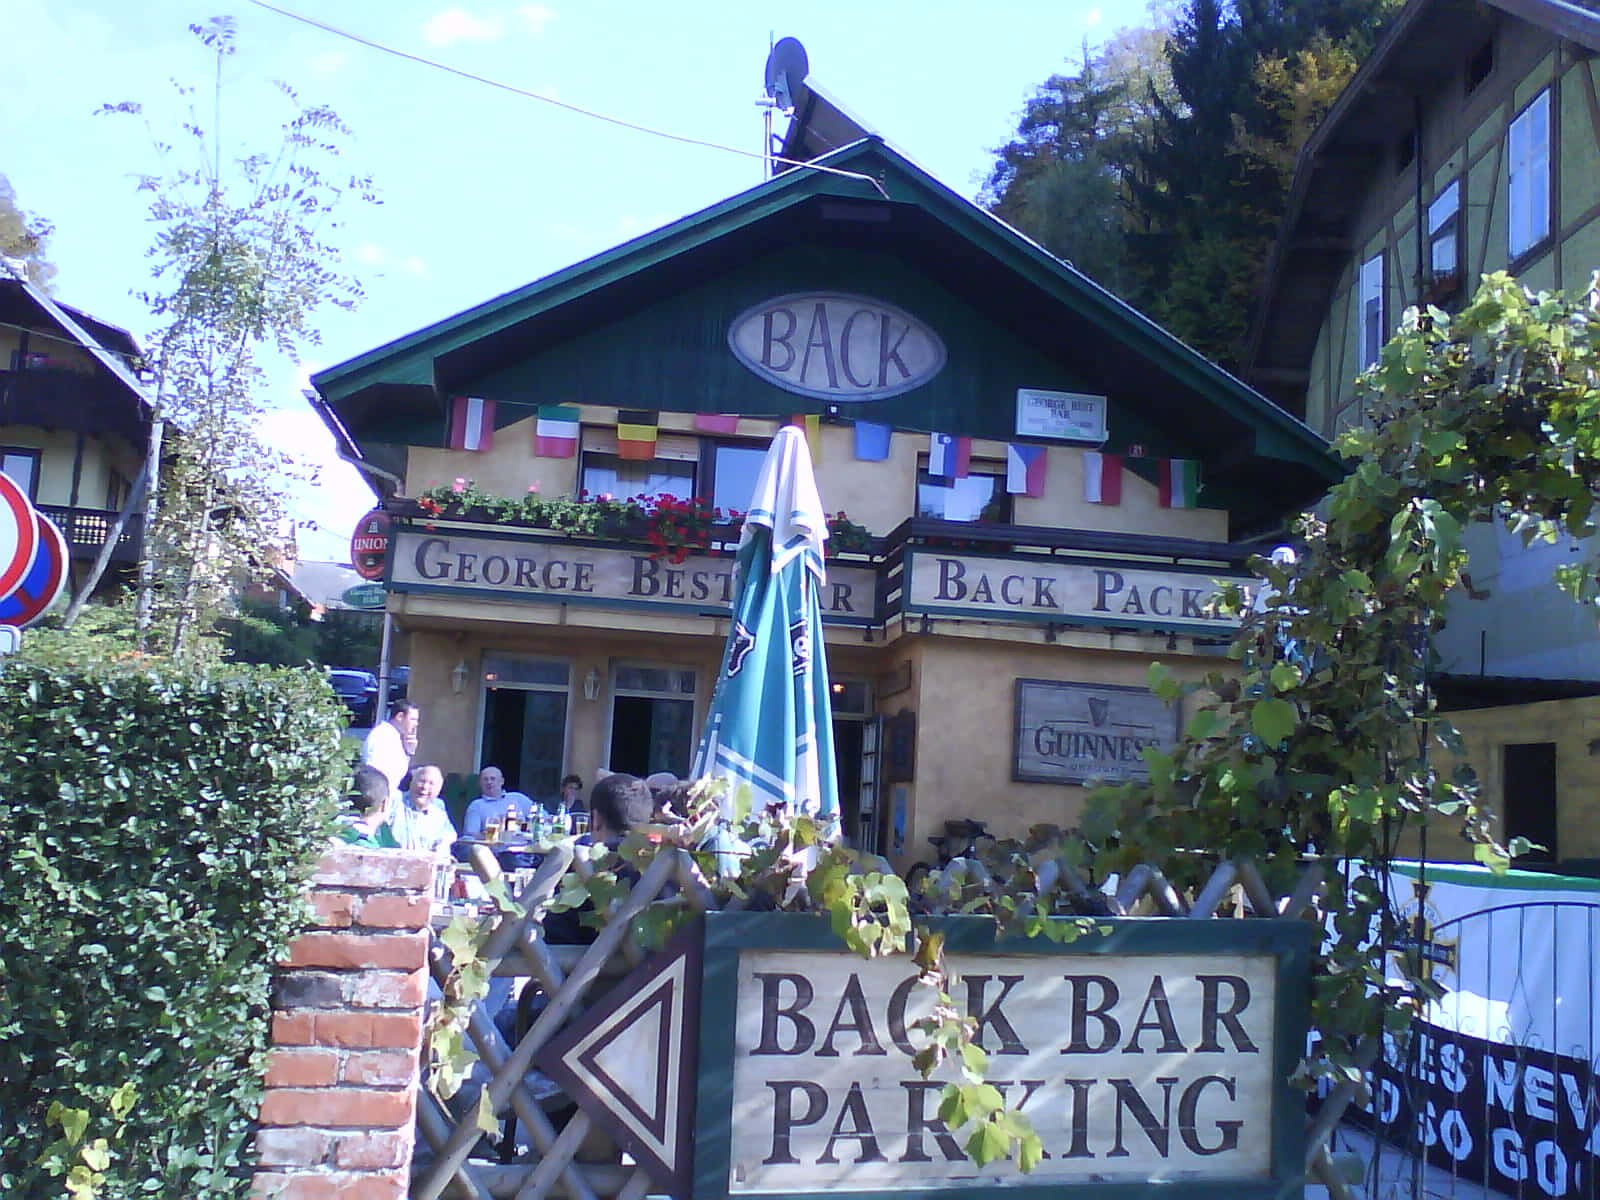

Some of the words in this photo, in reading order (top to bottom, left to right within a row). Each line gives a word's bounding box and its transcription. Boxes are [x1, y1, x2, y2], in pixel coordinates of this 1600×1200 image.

[760, 303, 912, 389] BACK
[415, 538, 594, 593] GEORGE
[628, 556, 735, 602] BEST
[934, 558, 1058, 609] BACK
[1093, 569, 1257, 622] PACK
[749, 972, 1030, 1057] BACK
[1060, 974, 1260, 1054] BAR
